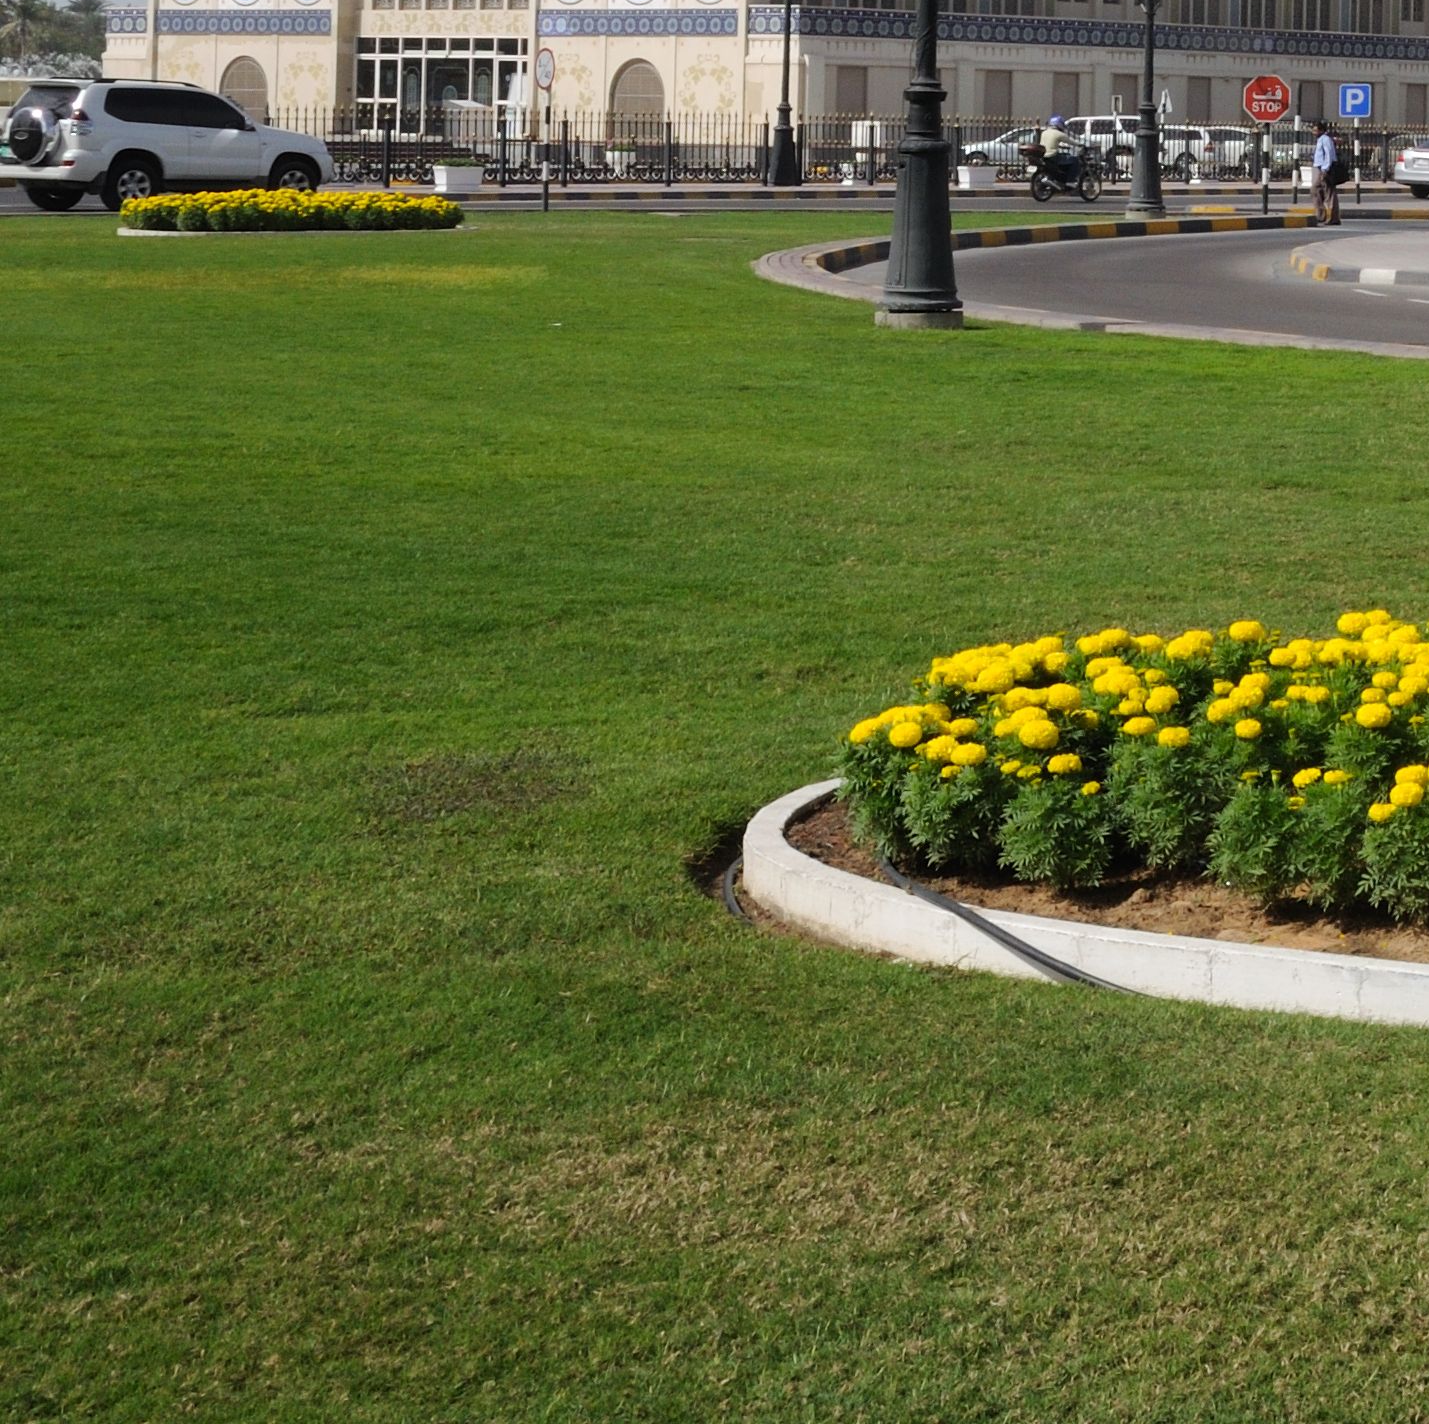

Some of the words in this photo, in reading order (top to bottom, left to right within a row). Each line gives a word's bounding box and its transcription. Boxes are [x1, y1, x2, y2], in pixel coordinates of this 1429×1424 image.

[1252, 85, 1283, 100] قف
[1251, 101, 1282, 113] STOP
[1345, 88, 1365, 113] P
